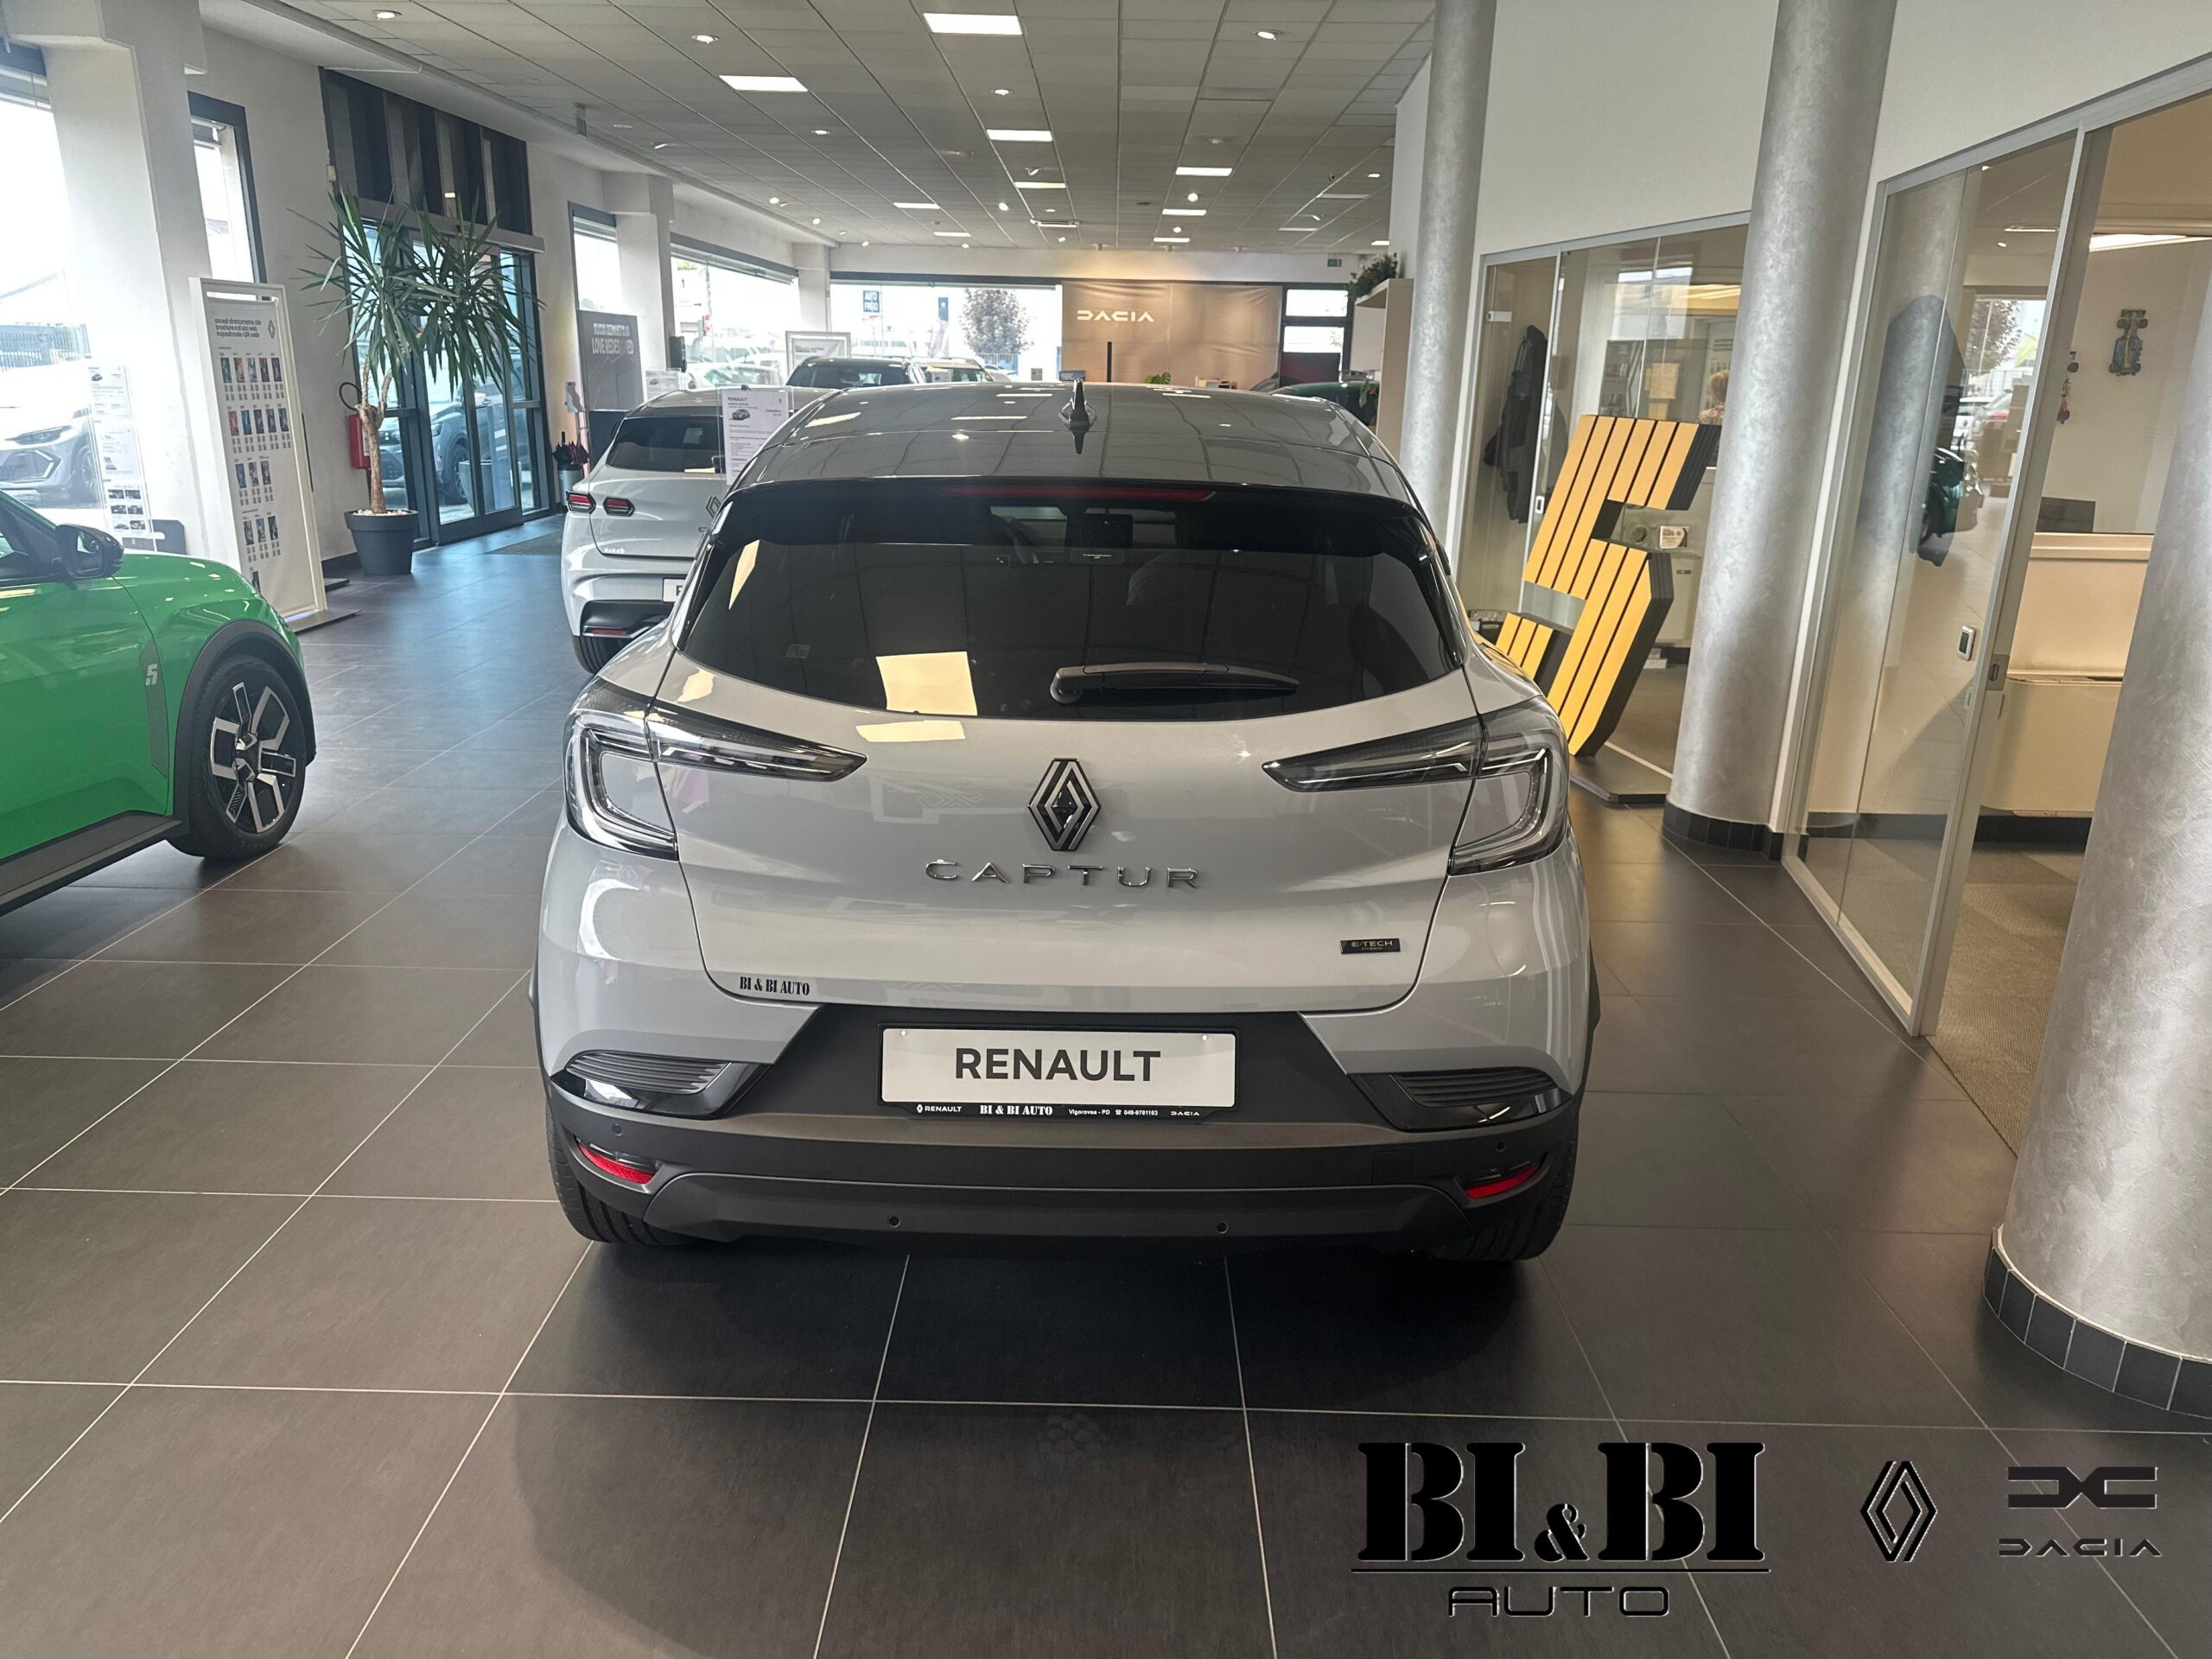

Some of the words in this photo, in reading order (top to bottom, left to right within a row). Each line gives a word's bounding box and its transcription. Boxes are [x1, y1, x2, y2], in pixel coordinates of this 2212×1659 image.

[1077, 310, 1154, 322] DACIA
[592, 337, 605, 353] LOVE
[925, 860, 1199, 889] CAPTUR
[740, 976, 752, 989] BI
[754, 978, 762, 991] &
[766, 979, 778, 993] BI
[780, 981, 810, 995] AUTO
[956, 1048, 1161, 1081] RENAULT
[980, 1105, 993, 1115] BI
[995, 1106, 1003, 1115] &
[1007, 1106, 1020, 1115] BI
[1022, 1106, 1052, 1116] AUTO
